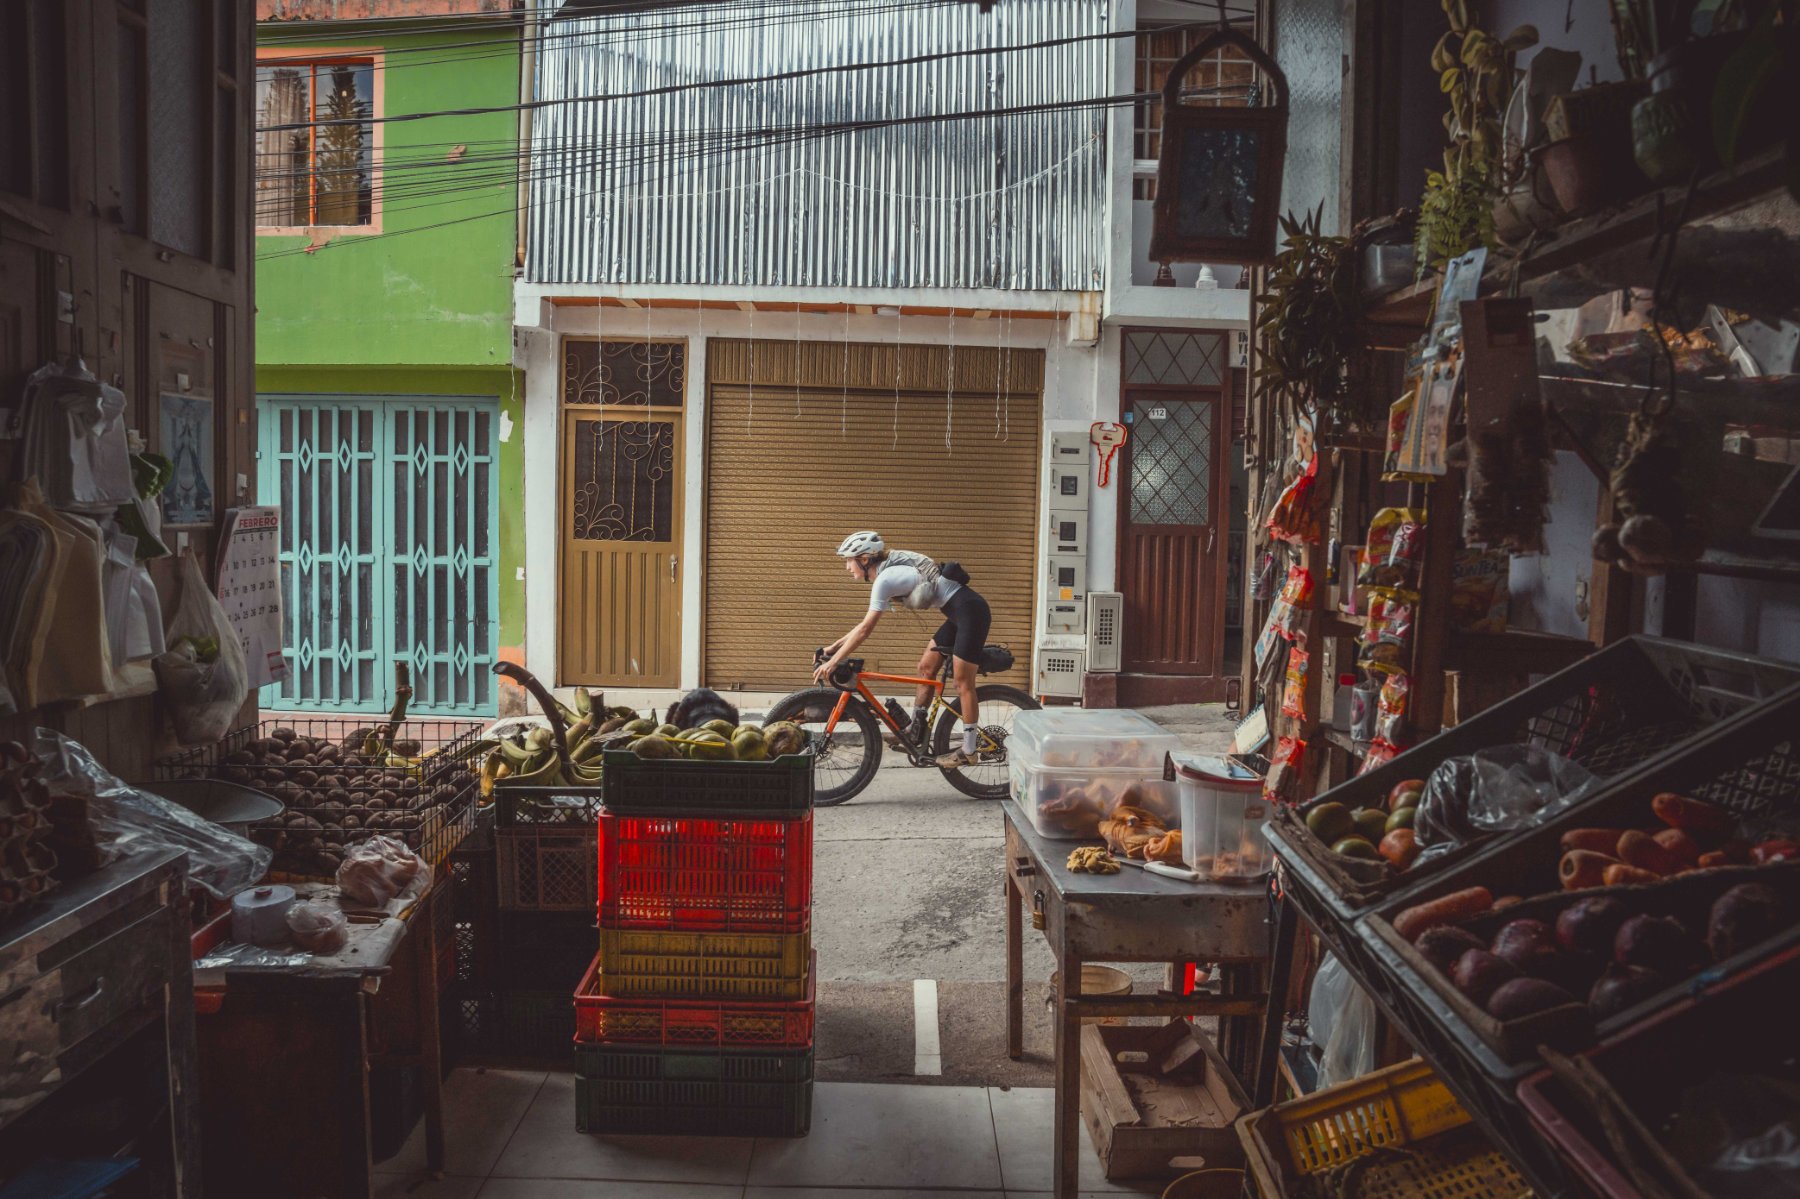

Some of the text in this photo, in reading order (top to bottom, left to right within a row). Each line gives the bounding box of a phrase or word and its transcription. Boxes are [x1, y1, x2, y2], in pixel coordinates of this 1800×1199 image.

[239, 516, 278, 528] FEBRERO
[259, 532, 264, 540] 6
[269, 532, 273, 540] 7
[268, 581, 275, 589] 21
[234, 613, 240, 622] 24
[243, 611, 248, 619] 25
[251, 609, 256, 617] 26
[258, 607, 265, 615] 27
[269, 605, 279, 614] 28
